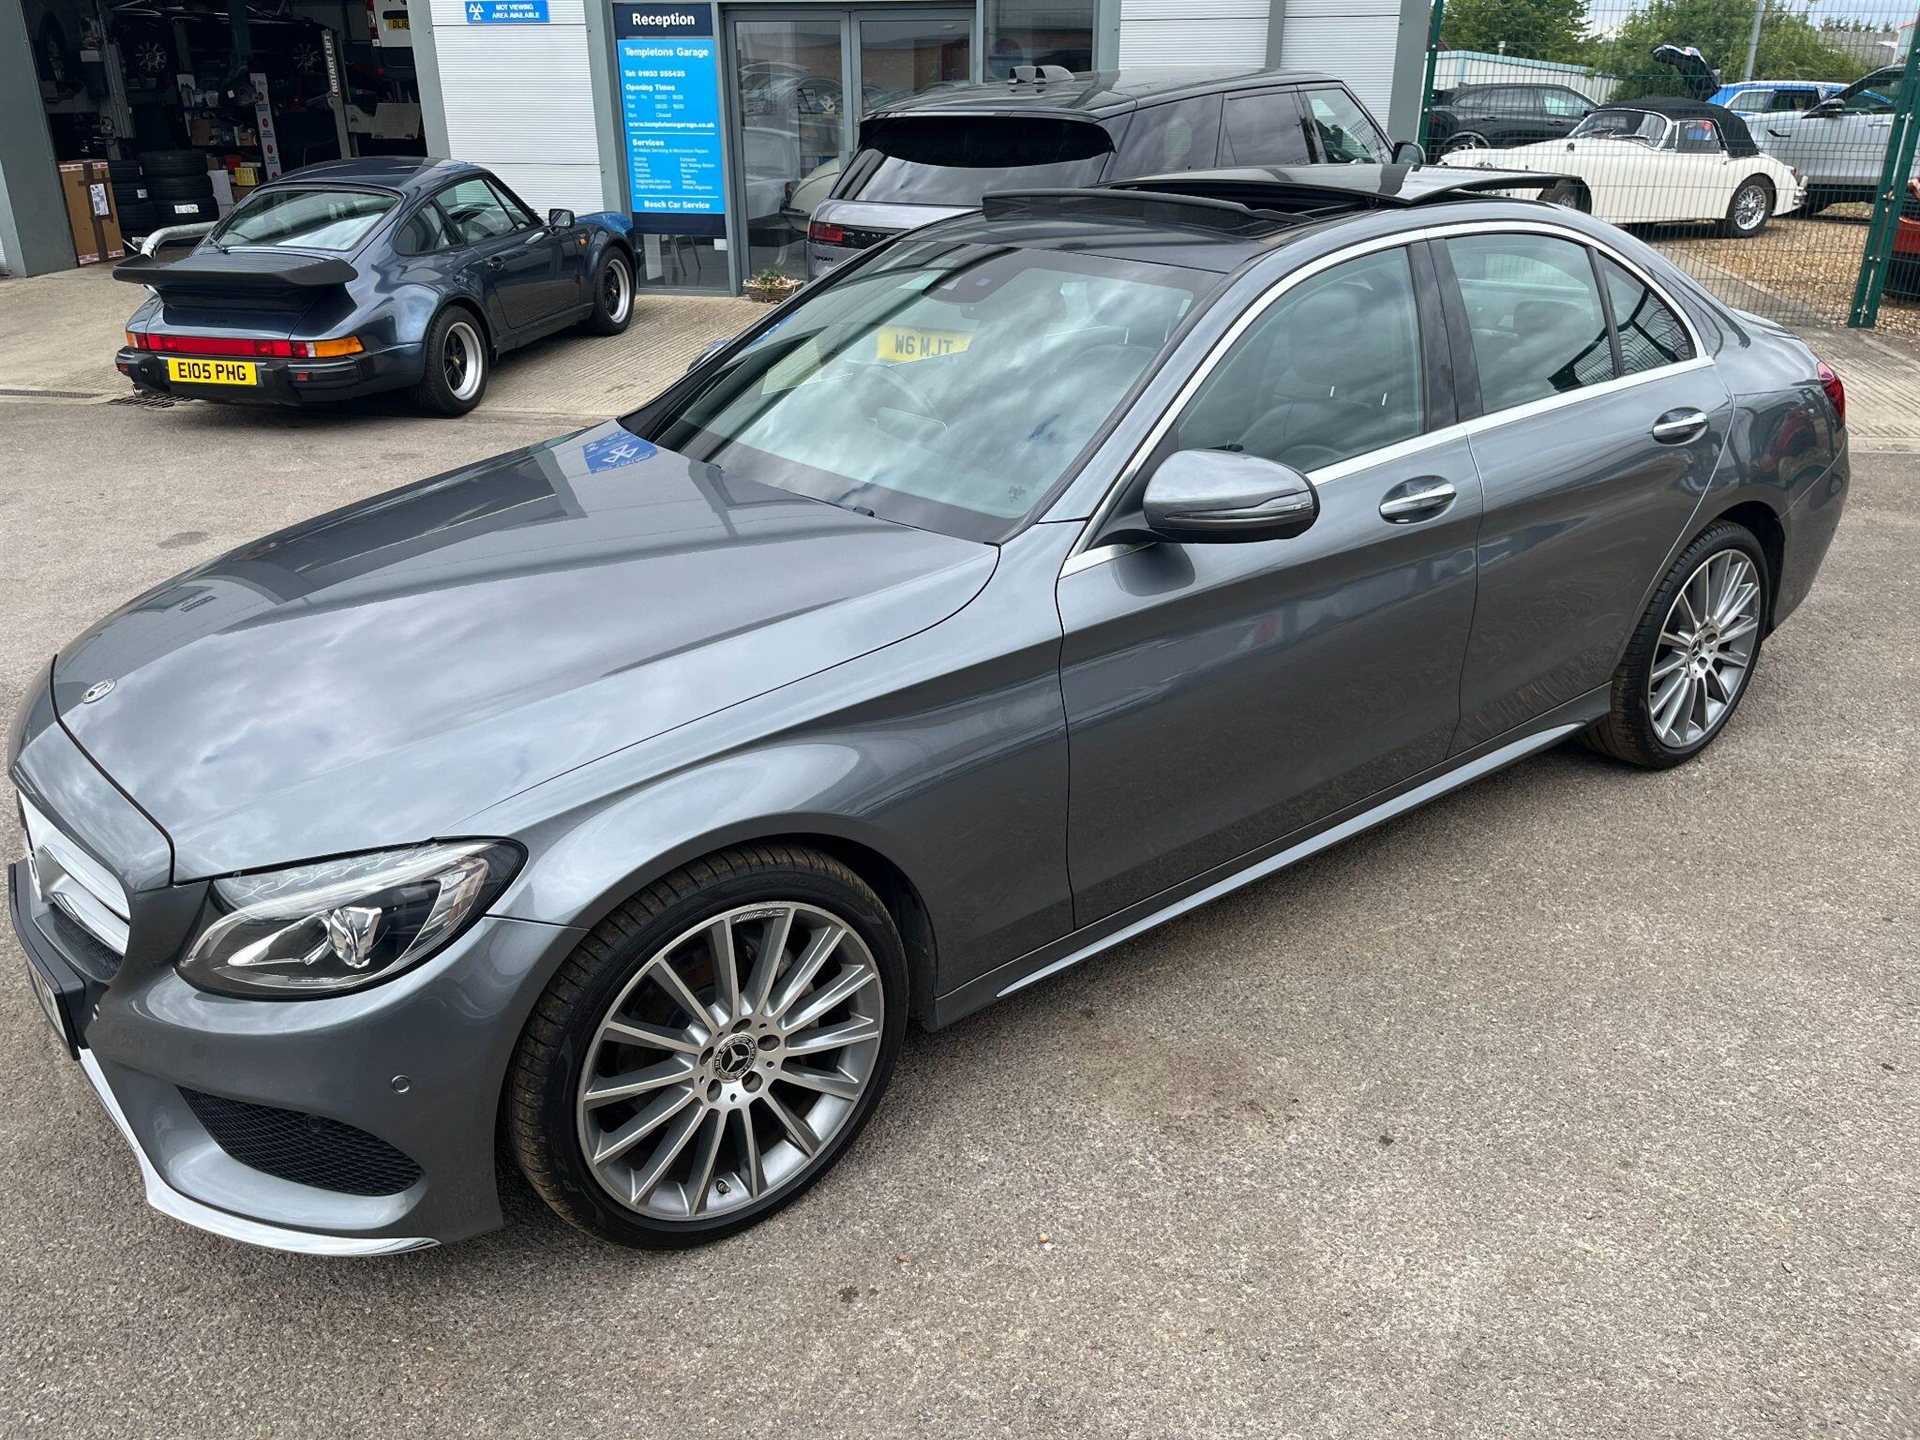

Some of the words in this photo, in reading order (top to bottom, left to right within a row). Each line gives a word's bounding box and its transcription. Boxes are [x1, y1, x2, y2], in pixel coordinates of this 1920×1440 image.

[509, 3, 535, 11] VIEWING
[632, 12, 696, 28] Reception
[324, 34, 333, 54] LIFT
[624, 47, 674, 59] Templetons
[676, 47, 709, 59] Garage
[327, 56, 340, 92] ROTARY
[625, 84, 654, 92] Opening
[632, 138, 665, 146] Services
[644, 200, 667, 208] Bosch
[682, 201, 711, 209] Service
[178, 362, 212, 380] E105
[215, 364, 247, 381] PHG
